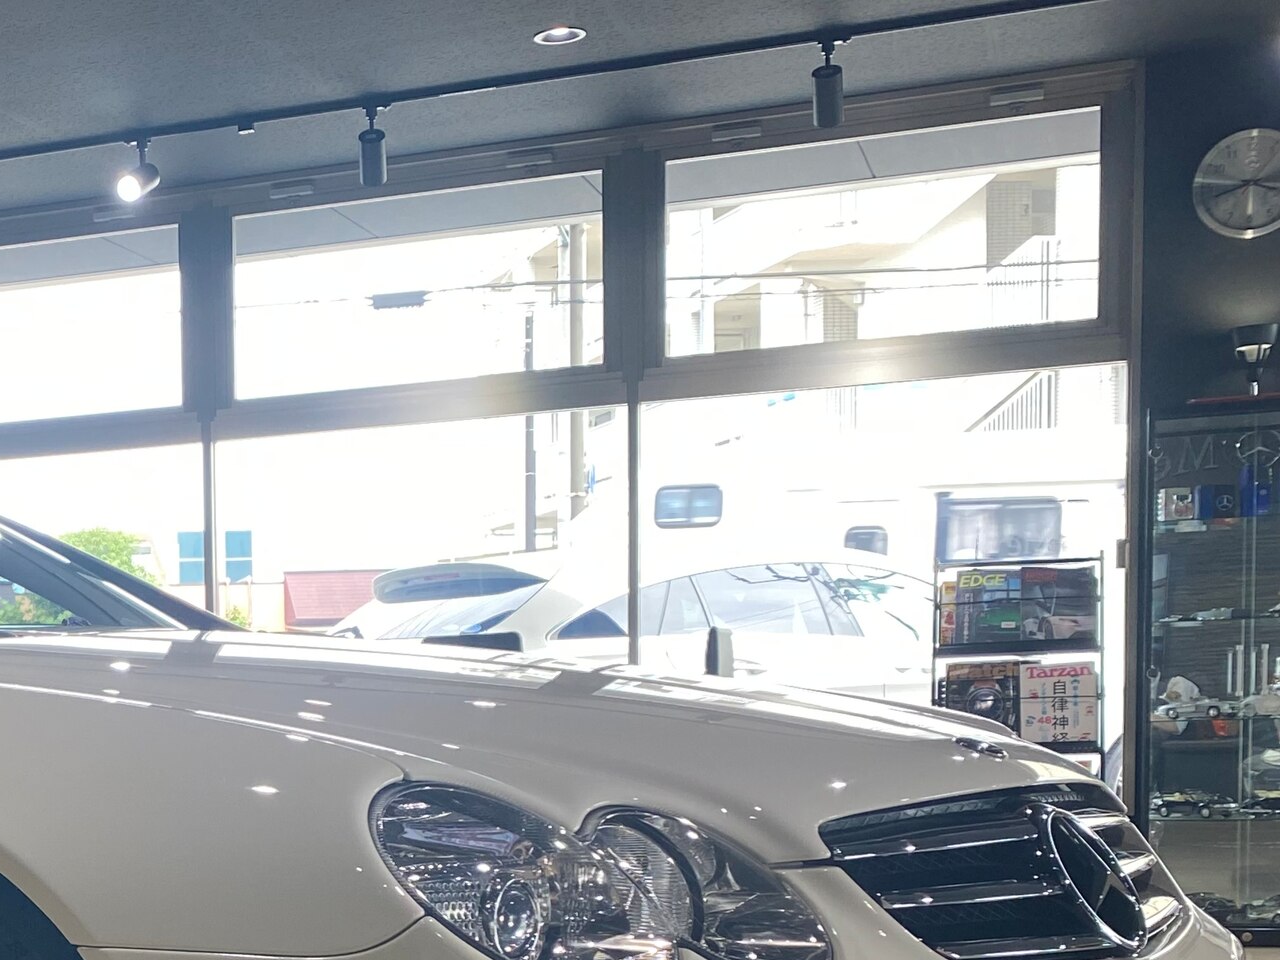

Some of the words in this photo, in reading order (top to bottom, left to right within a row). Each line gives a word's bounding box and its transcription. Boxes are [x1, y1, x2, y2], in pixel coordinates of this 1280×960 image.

[959, 573, 1007, 588] EDGE
[1026, 666, 1094, 679] Tarzan
[1037, 716, 1052, 724] 48
